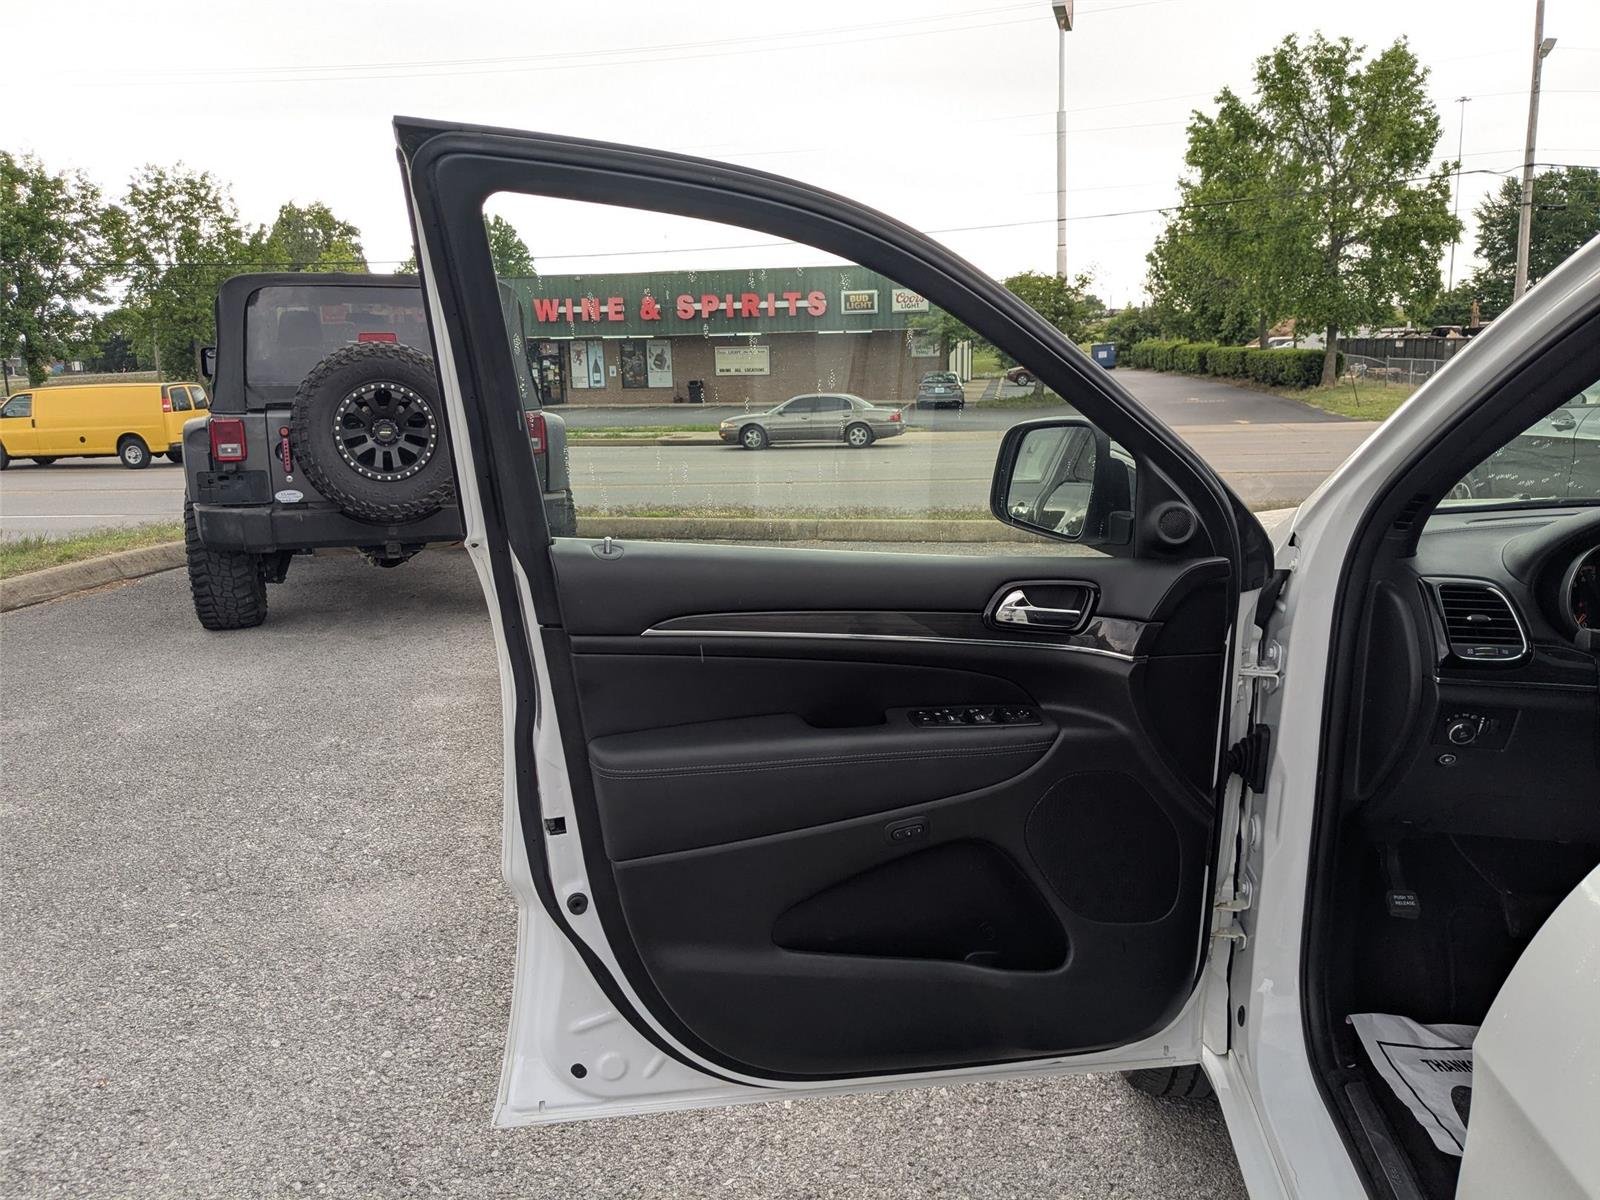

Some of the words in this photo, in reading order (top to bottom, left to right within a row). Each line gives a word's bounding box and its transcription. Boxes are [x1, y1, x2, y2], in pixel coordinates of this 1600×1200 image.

[849, 294, 869, 302] BUD
[896, 292, 925, 303] Coors
[533, 297, 625, 322] WINE
[640, 295, 662, 321] &
[676, 291, 827, 320] SPIRITS
[846, 301, 872, 309] LIGHT
[900, 302, 921, 310] LIGHT
